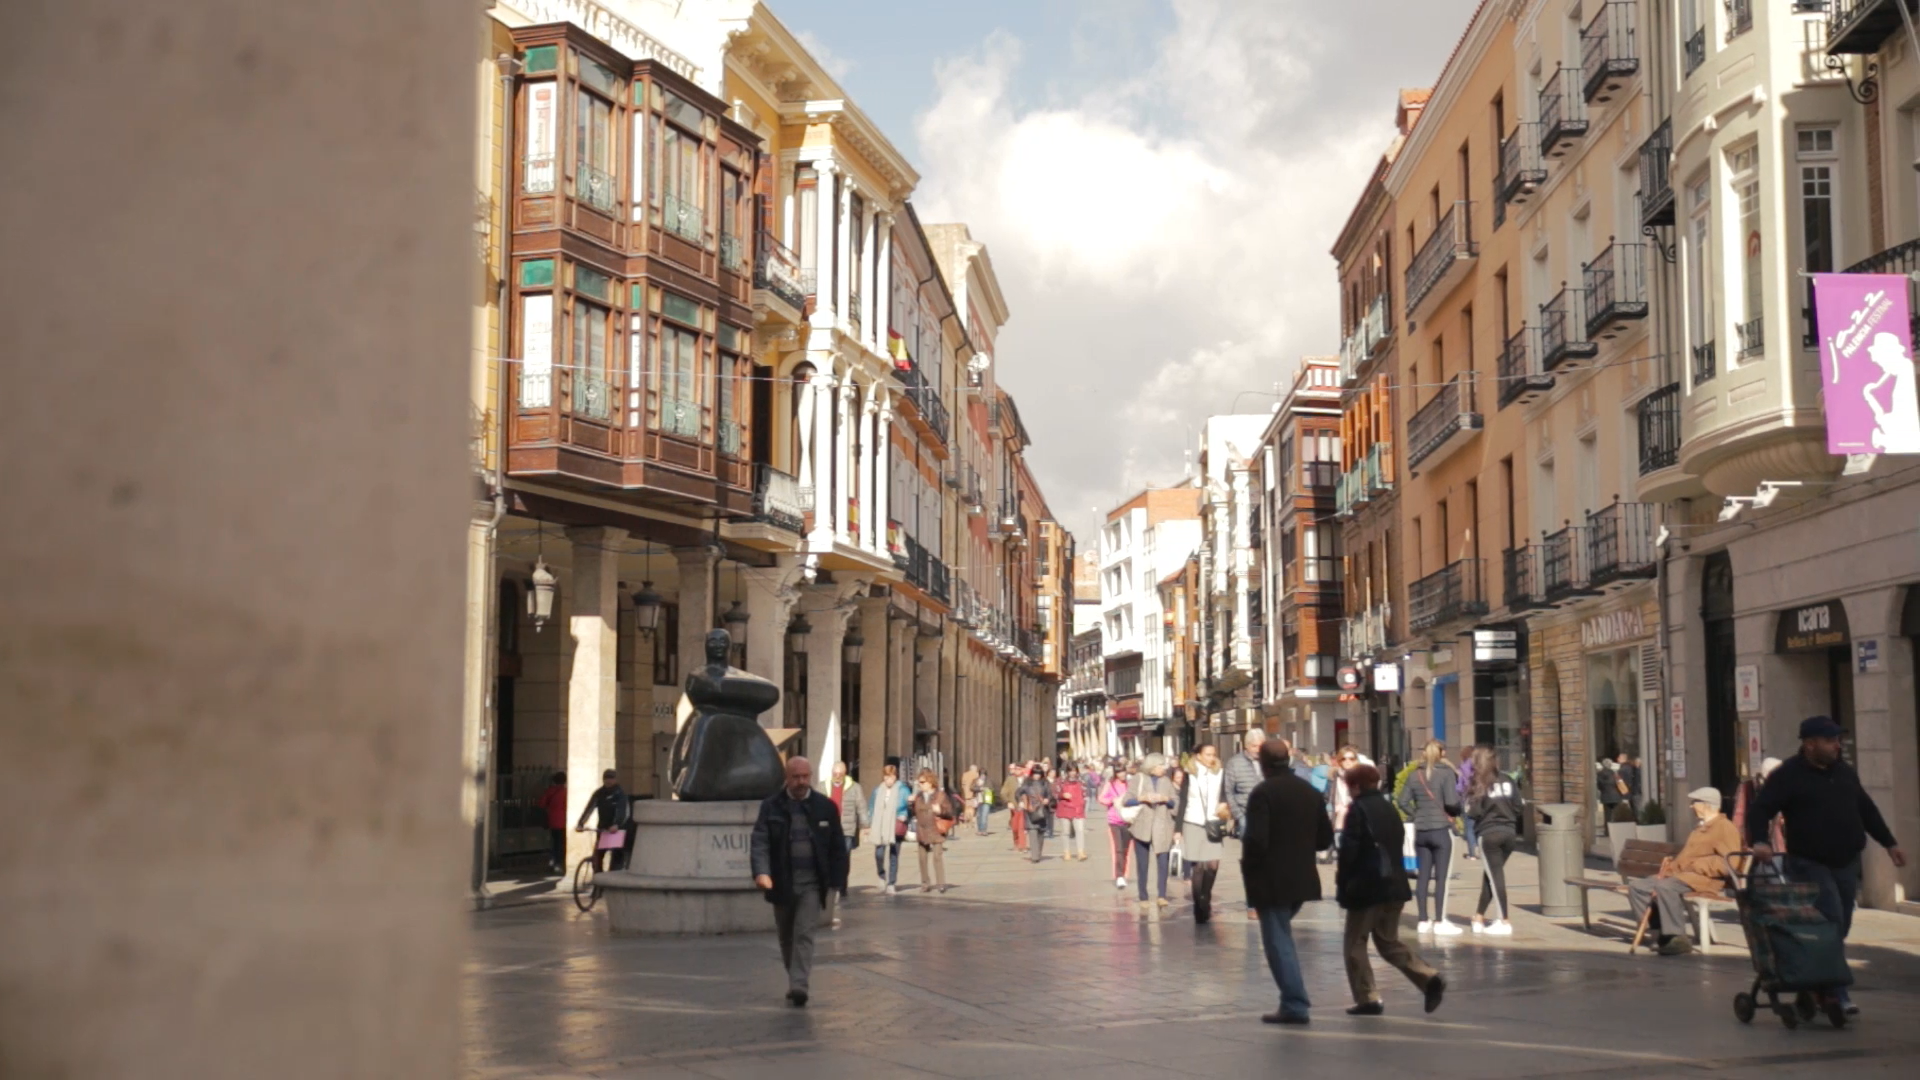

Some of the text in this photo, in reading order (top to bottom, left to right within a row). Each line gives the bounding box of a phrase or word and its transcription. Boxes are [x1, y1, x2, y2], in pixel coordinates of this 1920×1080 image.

[1841, 298, 1893, 358] PALENCIA FESTIVAL
[711, 833, 752, 853] MUJ
